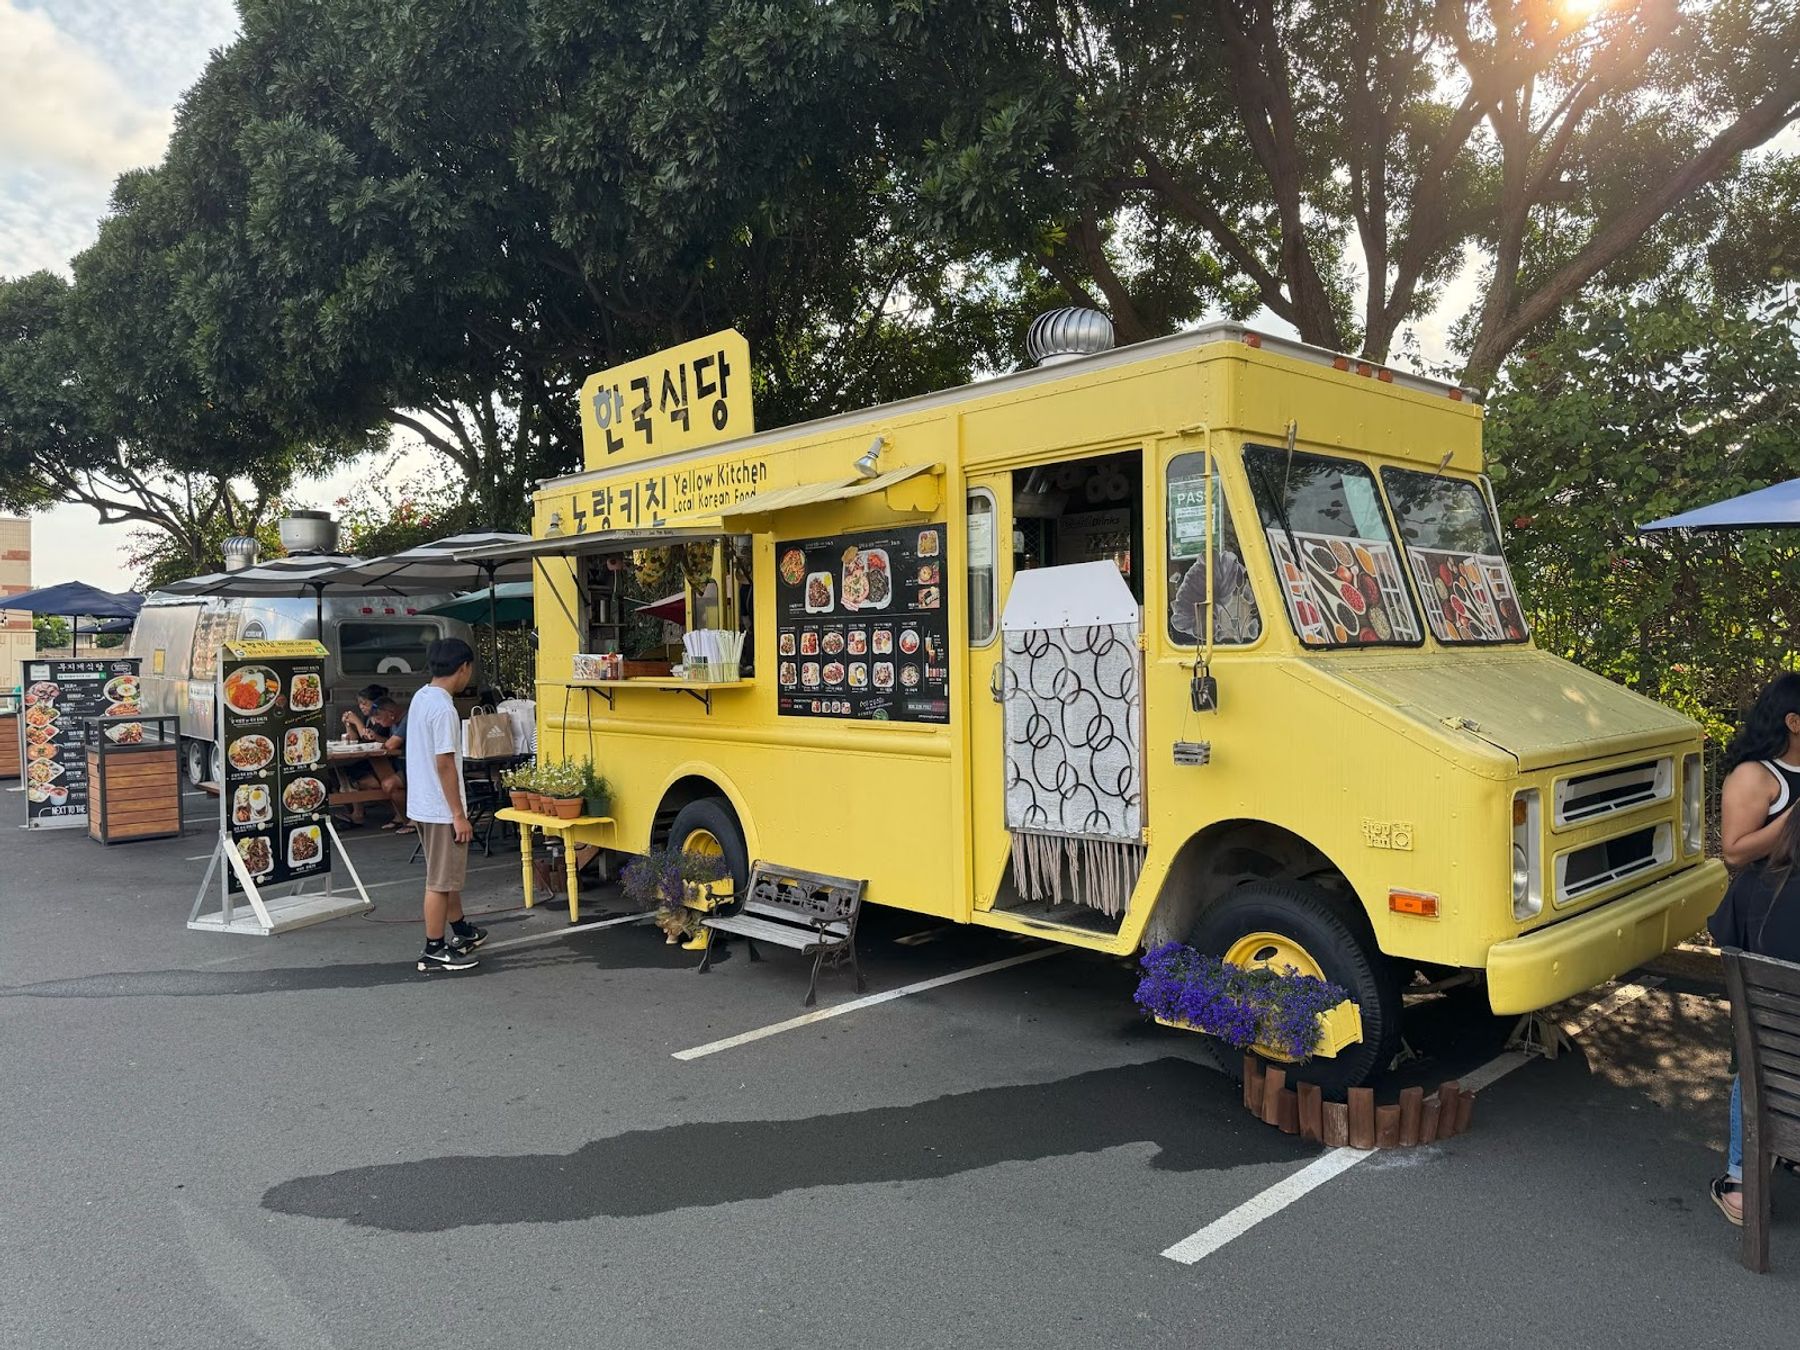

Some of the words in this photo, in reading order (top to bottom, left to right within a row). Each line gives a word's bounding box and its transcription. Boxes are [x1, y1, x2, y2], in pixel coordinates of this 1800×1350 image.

[593, 350, 730, 455] 한국식당
[674, 470, 713, 496] Yellow
[718, 460, 767, 488] Kitchen
[573, 476, 667, 534] 노랑키친
[673, 494, 695, 513] Local
[698, 491, 730, 509] Korean
[1177, 490, 1208, 505] PAS
[51, 806, 67, 815] NEXT
[67, 805, 75, 814] TO
